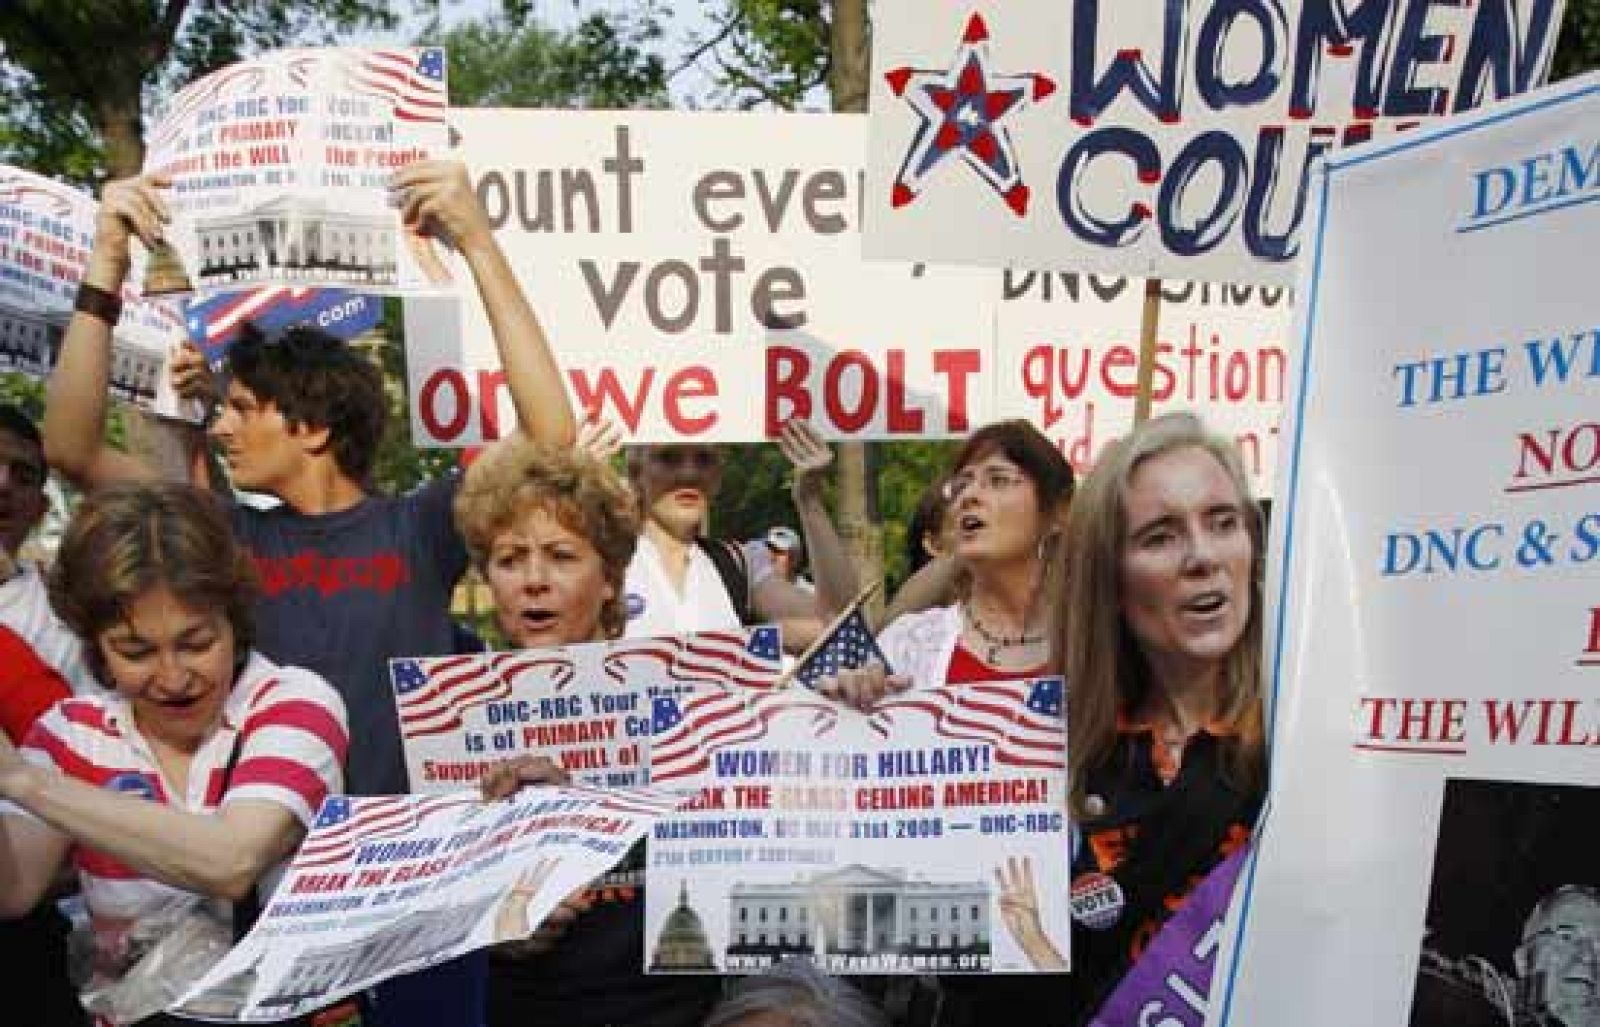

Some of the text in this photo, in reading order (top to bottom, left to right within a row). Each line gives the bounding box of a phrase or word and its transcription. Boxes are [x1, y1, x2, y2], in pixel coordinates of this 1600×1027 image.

[1068, 0, 1563, 124] WOMEN
[450, 125, 865, 235] ount eve
[1056, 120, 1420, 262] COU
[578, 238, 807, 334] vote
[567, 363, 719, 434] we
[764, 347, 981, 438] BOLT
[1021, 322, 1287, 430] question
[1394, 348, 1506, 407] THE
[1381, 523, 1505, 577] DNC
[1516, 520, 1558, 568] &
[487, 691, 638, 725] DNC-RBC Your
[523, 718, 617, 747] PRIMARY
[1360, 697, 1600, 746] THE WIL
[716, 744, 990, 779] WOMEN FOR HILLARY!
[733, 785, 772, 810] THE
[855, 784, 936, 812] CEILING
[944, 779, 1049, 808] AMERICA!
[355, 837, 443, 865] WOMEN
